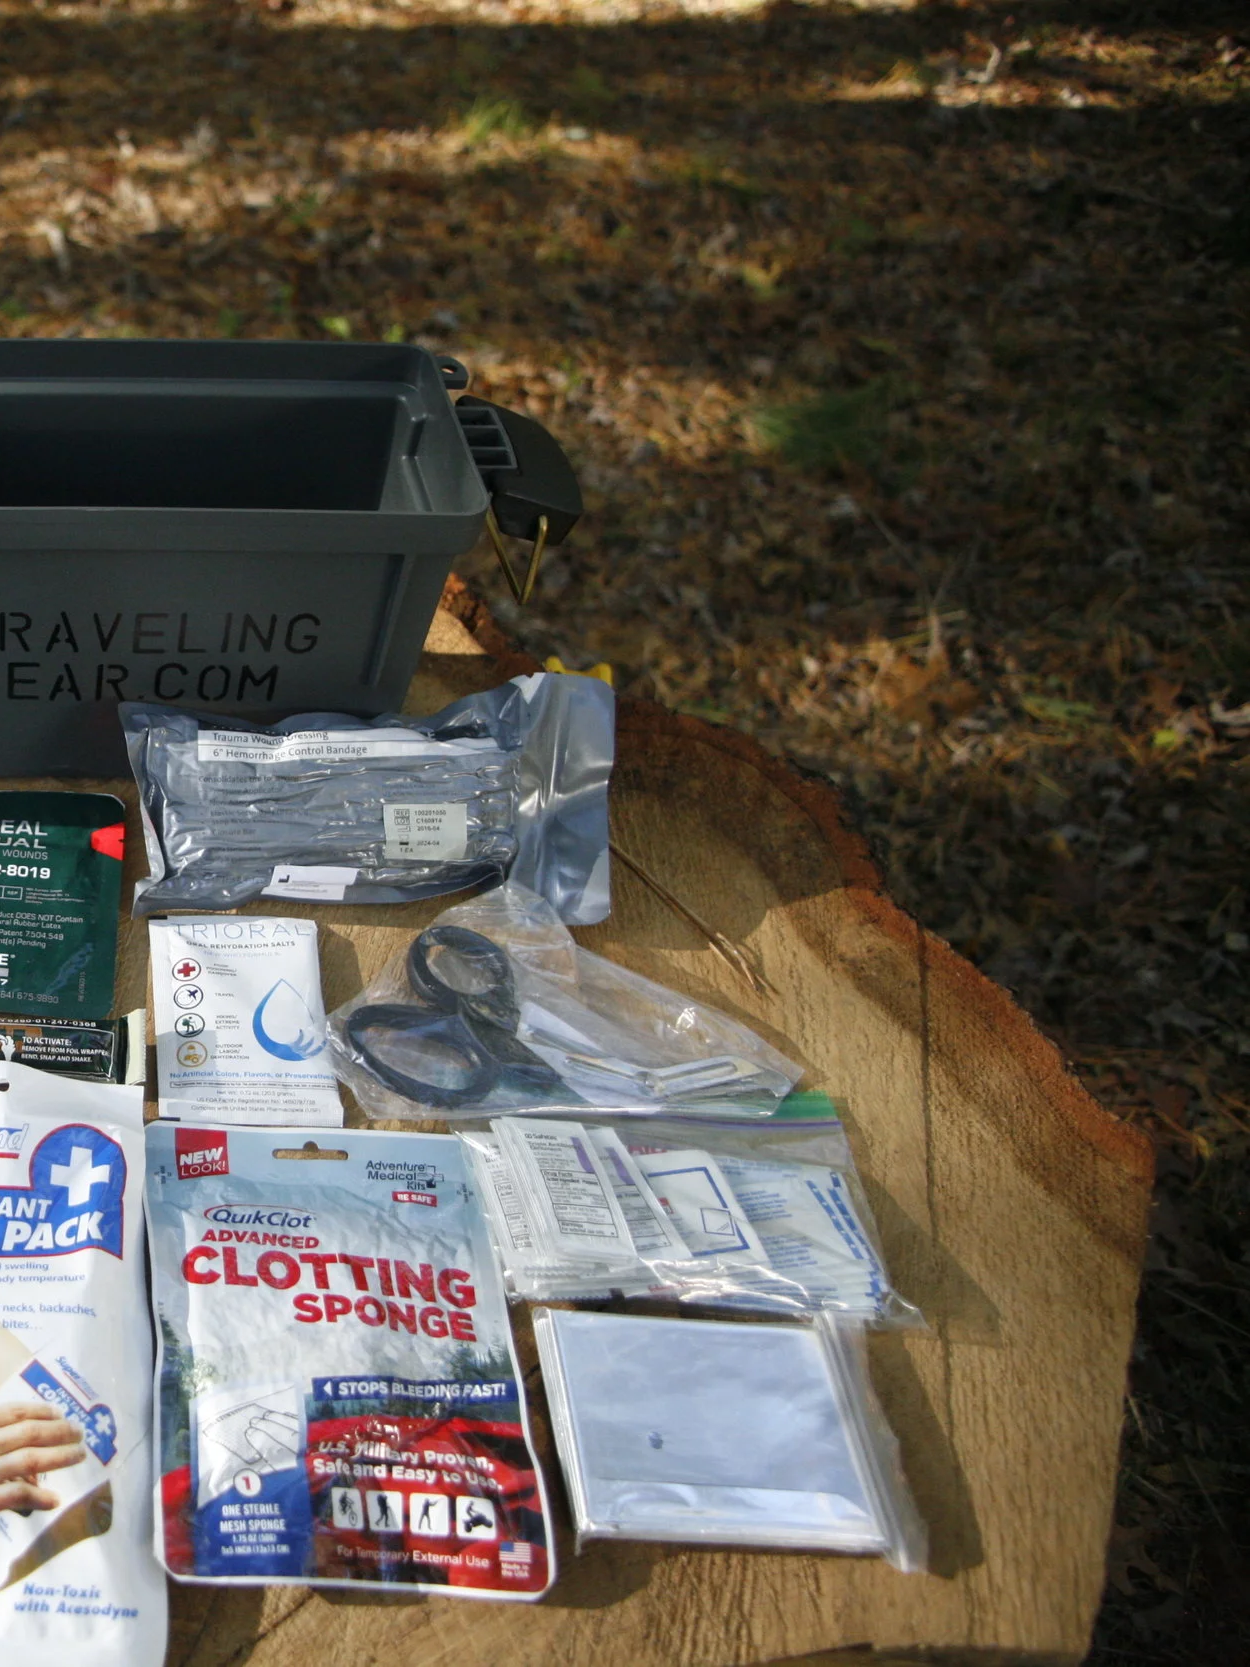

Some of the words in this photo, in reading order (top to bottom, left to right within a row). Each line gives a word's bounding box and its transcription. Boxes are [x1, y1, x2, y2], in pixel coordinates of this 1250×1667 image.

[213, 733, 248, 743] Trauma
[226, 748, 286, 761] Hemorrhage
[288, 746, 324, 756] Control
[327, 745, 368, 756] Bandage
[2, 850, 48, 860] WOUNDS
[13, 918, 40, 928] Rubber
[41, 922, 61, 930] Latex
[15, 911, 36, 920] DOES
[38, 913, 54, 922] NOT
[55, 914, 84, 923] Contain
[16, 938, 46, 949] Pending
[210, 941, 269, 949] REHYDRATION
[22, 1036, 32, 1044] TO
[34, 1036, 72, 1047] ACTIVATE:
[21, 1045, 47, 1053] REMOVE
[48, 1046, 65, 1054] FROM
[66, 1047, 79, 1055] FOIL
[39, 1054, 56, 1062] SNAP
[179, 1146, 225, 1166] NEW
[181, 1161, 226, 1177] LOOK!
[366, 1160, 425, 1172] Adventure
[367, 1170, 417, 1181] Medical
[406, 1180, 426, 1190] Kits
[397, 1193, 410, 1201] BE
[410, 1194, 433, 1204] SAFE
[211, 1207, 313, 1229] QuikClot
[1, 1210, 105, 1252] PACK
[201, 1229, 320, 1249] ADVANCED
[4, 1261, 49, 1272] swelling
[18, 1273, 86, 1283] temperature
[181, 1245, 477, 1309] CLOTTING
[3, 1303, 36, 1314] necks,
[39, 1303, 97, 1318] backaches,
[293, 1293, 478, 1342] SPONGE
[338, 1381, 389, 1396] STOPS
[391, 1382, 461, 1399] BLEEDING
[462, 1382, 507, 1397] FAST!
[354, 1440, 420, 1465] Military
[423, 1450, 495, 1472] Proven,
[313, 1458, 350, 1475] Safe
[353, 1462, 388, 1478] and
[391, 1465, 437, 1485] Easy
[441, 1469, 462, 1483] to
[465, 1470, 504, 1491] Use.
[221, 1503, 242, 1517] ONE
[243, 1503, 281, 1516] STERILE
[219, 1520, 247, 1533] MESH
[248, 1518, 286, 1532] SPONGE
[336, 1544, 354, 1556] For
[356, 1546, 410, 1561] Temporary
[412, 1550, 462, 1565] External
[465, 1554, 490, 1568] Use
[23, 1582, 101, 1599] Non-Toxic
[14, 1599, 50, 1614] with
[56, 1601, 139, 1620] Acesodyne
